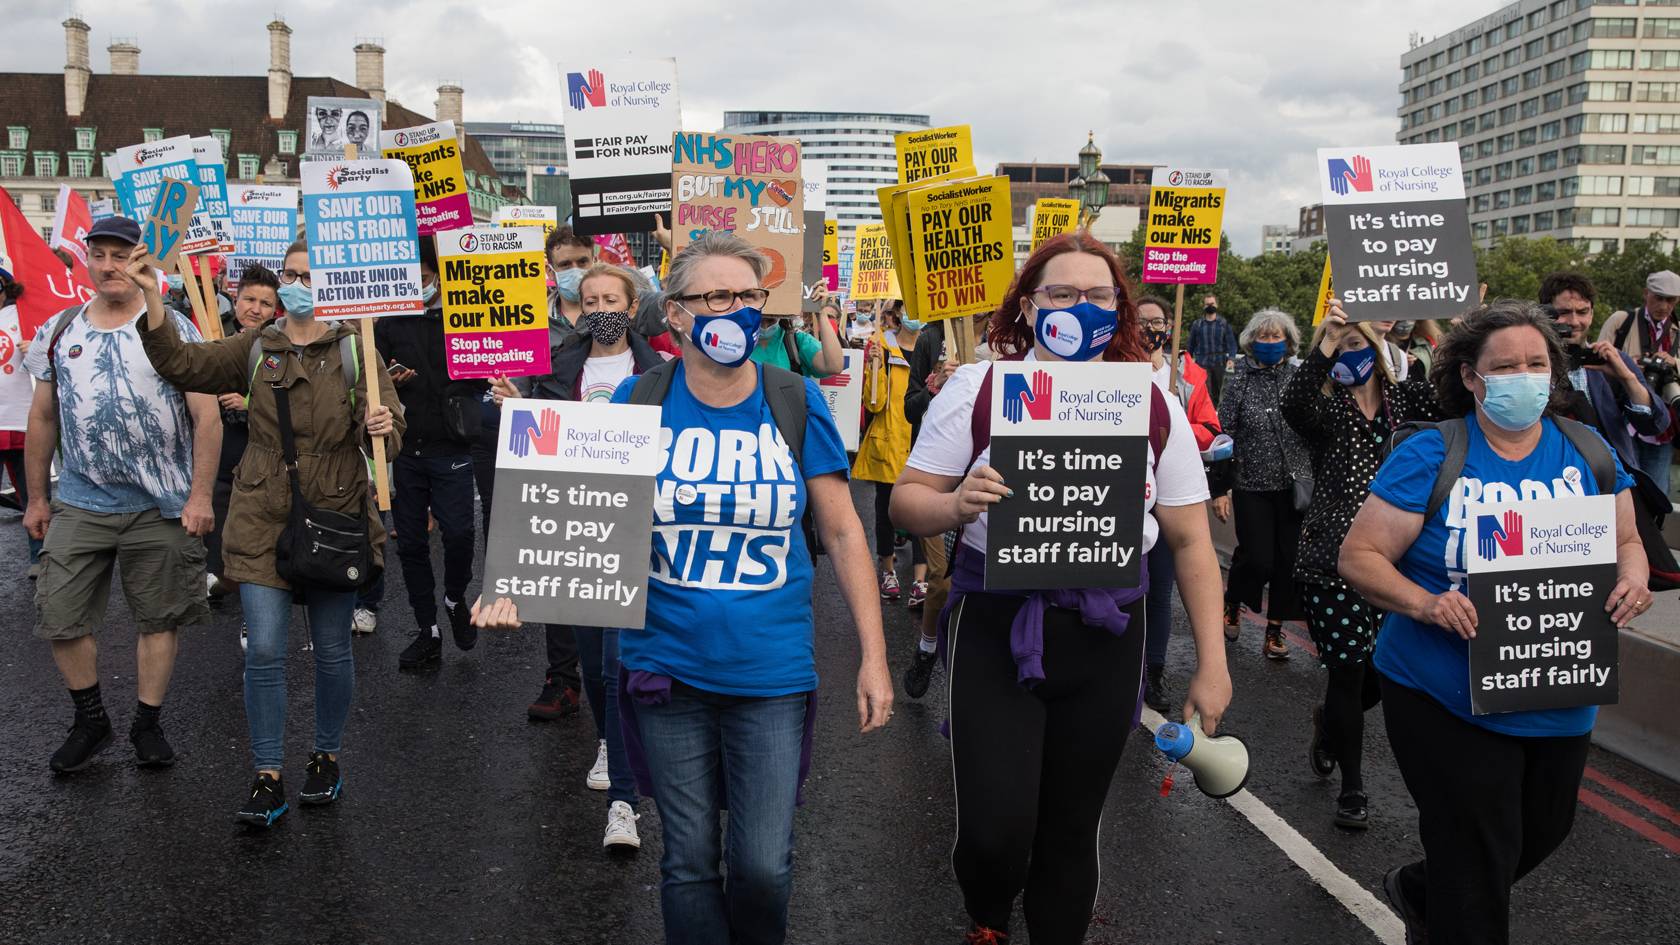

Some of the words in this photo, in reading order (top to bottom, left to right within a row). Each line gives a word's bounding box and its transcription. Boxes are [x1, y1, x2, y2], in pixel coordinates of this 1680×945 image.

[610, 82, 636, 96] Royal
[637, 80, 671, 95] College
[611, 96, 621, 106] of
[622, 96, 660, 108] Nursing
[409, 131, 427, 139] STAND
[419, 134, 440, 143] RACISM
[595, 137, 623, 147] FAIR
[626, 135, 648, 145] PAY
[596, 148, 621, 158] FOR
[674, 132, 733, 169] NHS
[734, 141, 798, 175] HERO
[905, 151, 926, 168] PAY
[932, 147, 958, 165] OUR
[132, 169, 160, 188] SAVE
[199, 168, 216, 183] UR
[341, 167, 389, 176] Socialist
[413, 170, 432, 182] ke
[1378, 167, 1409, 178] Royal
[1412, 166, 1452, 178] College
[424, 177, 456, 199] NHS
[678, 175, 724, 202] BUT
[724, 176, 767, 206] MY
[1380, 181, 1392, 192] of
[1394, 180, 1439, 192] Nursing
[605, 191, 670, 202] rcn.org.uk/fairpay
[1154, 191, 1221, 211] Migrants
[134, 206, 151, 221] TH
[318, 198, 363, 218] SAVE
[366, 196, 402, 216] OUR
[422, 205, 436, 214] the
[606, 203, 672, 214] #FairPayForNursin
[233, 210, 261, 223] SAVE
[264, 211, 288, 224] OUR
[418, 210, 460, 227] pegoating
[678, 204, 737, 231] PURSE
[922, 209, 952, 232] PAY
[959, 203, 992, 226] OUR
[1037, 214, 1049, 226] PAY
[1052, 214, 1069, 226] OUR
[1152, 211, 1195, 226] make
[1349, 213, 1384, 230] It's
[1389, 211, 1445, 228] time
[193, 226, 211, 238] 15%
[216, 232, 231, 241] 5%
[233, 225, 254, 239] NHS
[256, 226, 289, 240] FROM
[318, 221, 354, 241] NHS
[358, 218, 407, 239] FROM
[480, 234, 505, 243] STAND
[506, 233, 518, 241] UP
[923, 225, 983, 252] HEALTH
[1151, 231, 1178, 243] our
[1181, 228, 1212, 244] NHS
[312, 244, 346, 265] THE
[348, 240, 416, 263] TORIES!
[481, 243, 491, 251] TO
[493, 241, 522, 250] RACISM
[861, 238, 877, 248] PAY
[1362, 238, 1387, 253] to
[1394, 238, 1437, 256] pay
[860, 248, 892, 259] HEALTH
[924, 242, 1003, 272] WORKERS
[1148, 250, 1170, 262] Stop
[1172, 251, 1188, 261] the
[445, 259, 540, 285] Migrants
[859, 259, 896, 271] WORKER
[1147, 262, 1206, 273] scapegoating
[1358, 258, 1449, 278] nursing
[326, 271, 366, 286] TRADE
[369, 268, 407, 283] UNION
[858, 271, 889, 282] STRIKE
[926, 265, 983, 292] STRIKE
[318, 285, 365, 302] ACTION
[368, 284, 389, 298] FOR
[392, 283, 419, 297] 15%
[448, 284, 505, 305] make
[857, 283, 868, 294] TO
[872, 282, 889, 293] WIN
[928, 292, 948, 311] TO
[954, 284, 986, 307] WIN
[1344, 284, 1401, 303] staff
[1407, 282, 1470, 302] fairly
[322, 302, 416, 314] www.socialistparty.org.uk
[449, 310, 484, 328] our
[489, 304, 534, 327] NHS
[452, 338, 480, 351] Stop
[483, 337, 503, 349] the
[452, 350, 534, 365] scapegoating
[1059, 390, 1094, 408] Royal
[1097, 389, 1142, 408] College
[1058, 408, 1073, 421] of
[1074, 409, 1122, 426] Nursing
[566, 428, 601, 445] Royal
[604, 430, 650, 448] College
[564, 444, 578, 457] of
[581, 446, 630, 464] Nursing
[1018, 450, 1056, 470] It's
[1063, 448, 1123, 470] time
[521, 483, 560, 504] It's
[567, 484, 629, 508] time
[1028, 482, 1055, 501] to
[1062, 485, 1110, 506] pay
[696, 483, 797, 528] THE
[530, 515, 558, 535] to
[565, 520, 615, 543] pay
[1018, 510, 1116, 536] nursing
[1530, 525, 1562, 543] Royal
[1565, 523, 1609, 539] College
[650, 528, 786, 585] NHS
[998, 542, 1062, 564] staff
[1067, 542, 1134, 568] fairly
[1530, 542, 1543, 555] of
[1545, 541, 1591, 555] Nursing
[518, 546, 620, 575] nursing
[495, 576, 562, 597] staff
[568, 578, 639, 607] fairly
[1495, 582, 1531, 603] It's
[1537, 579, 1594, 600] time
[1505, 613, 1532, 631] to
[1539, 611, 1584, 633] pay
[1500, 636, 1592, 661] nursing
[1481, 667, 1541, 691] staff
[1547, 663, 1611, 687] fairly
